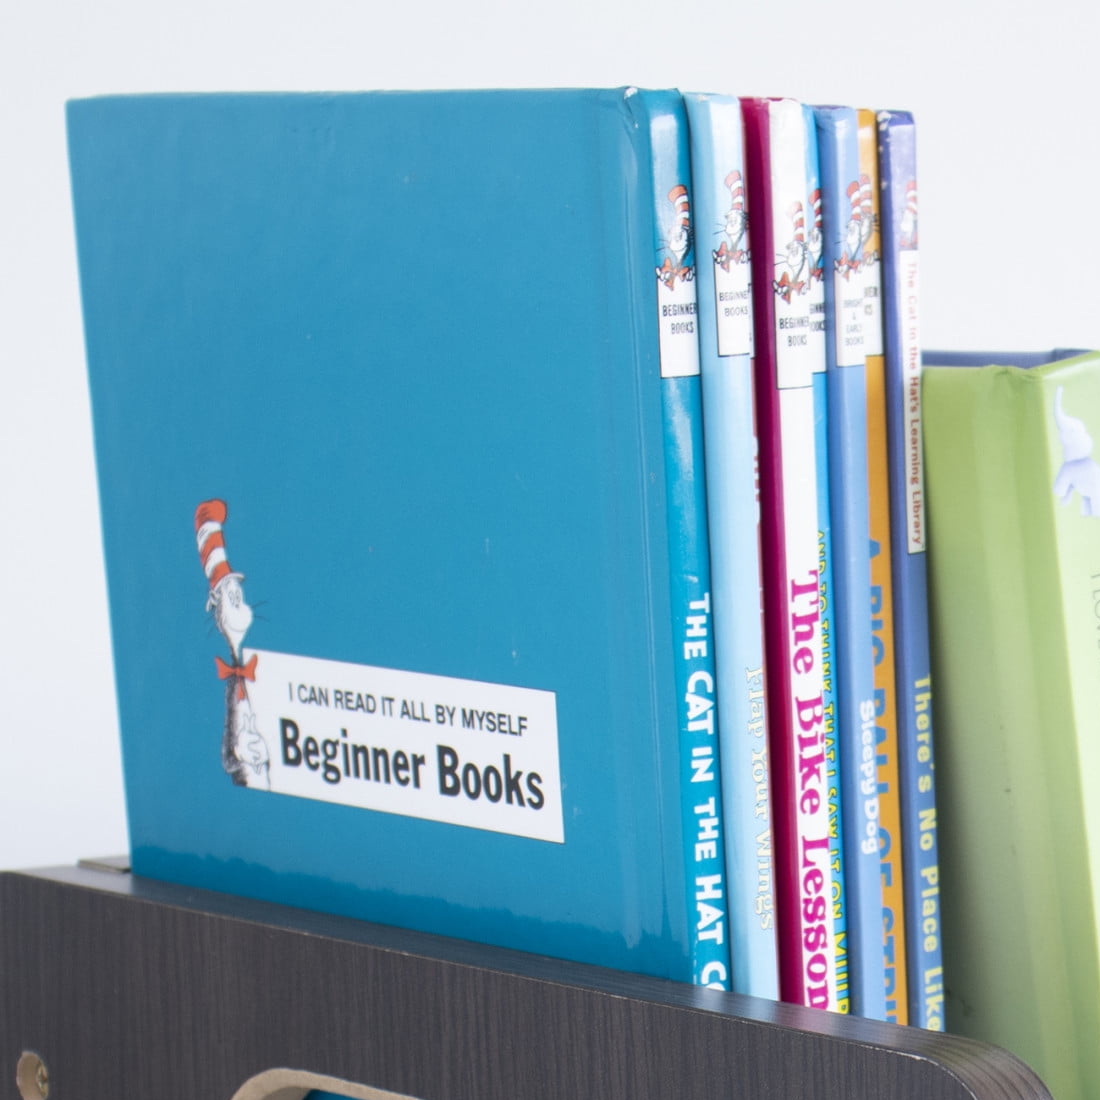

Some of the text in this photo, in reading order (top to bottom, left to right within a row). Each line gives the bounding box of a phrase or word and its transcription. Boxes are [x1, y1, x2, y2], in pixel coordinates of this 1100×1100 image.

[671, 321, 694, 335] BOOKS
[719, 290, 749, 302] BEGINNE
[724, 306, 748, 317] BOOKS
[787, 334, 808, 347] BOOKS
[910, 346, 918, 370] the
[909, 376, 919, 413] Hat's
[910, 418, 921, 485] Learning
[912, 490, 921, 544] Library
[684, 592, 710, 660] THE
[288, 682, 528, 737] I CAN READ IT ALL BY MYSELF
[685, 670, 714, 735] CAT
[279, 717, 545, 811] Beginner Books
[690, 746, 715, 783] IN
[791, 568, 829, 1011] The Bike Lesson
[859, 698, 879, 855] Sleepy Dog
[694, 797, 719, 862] THE
[745, 666, 774, 931] Flap Your Wings
[914, 674, 944, 1031] There's No Place Like
[695, 873, 724, 944] HAT
